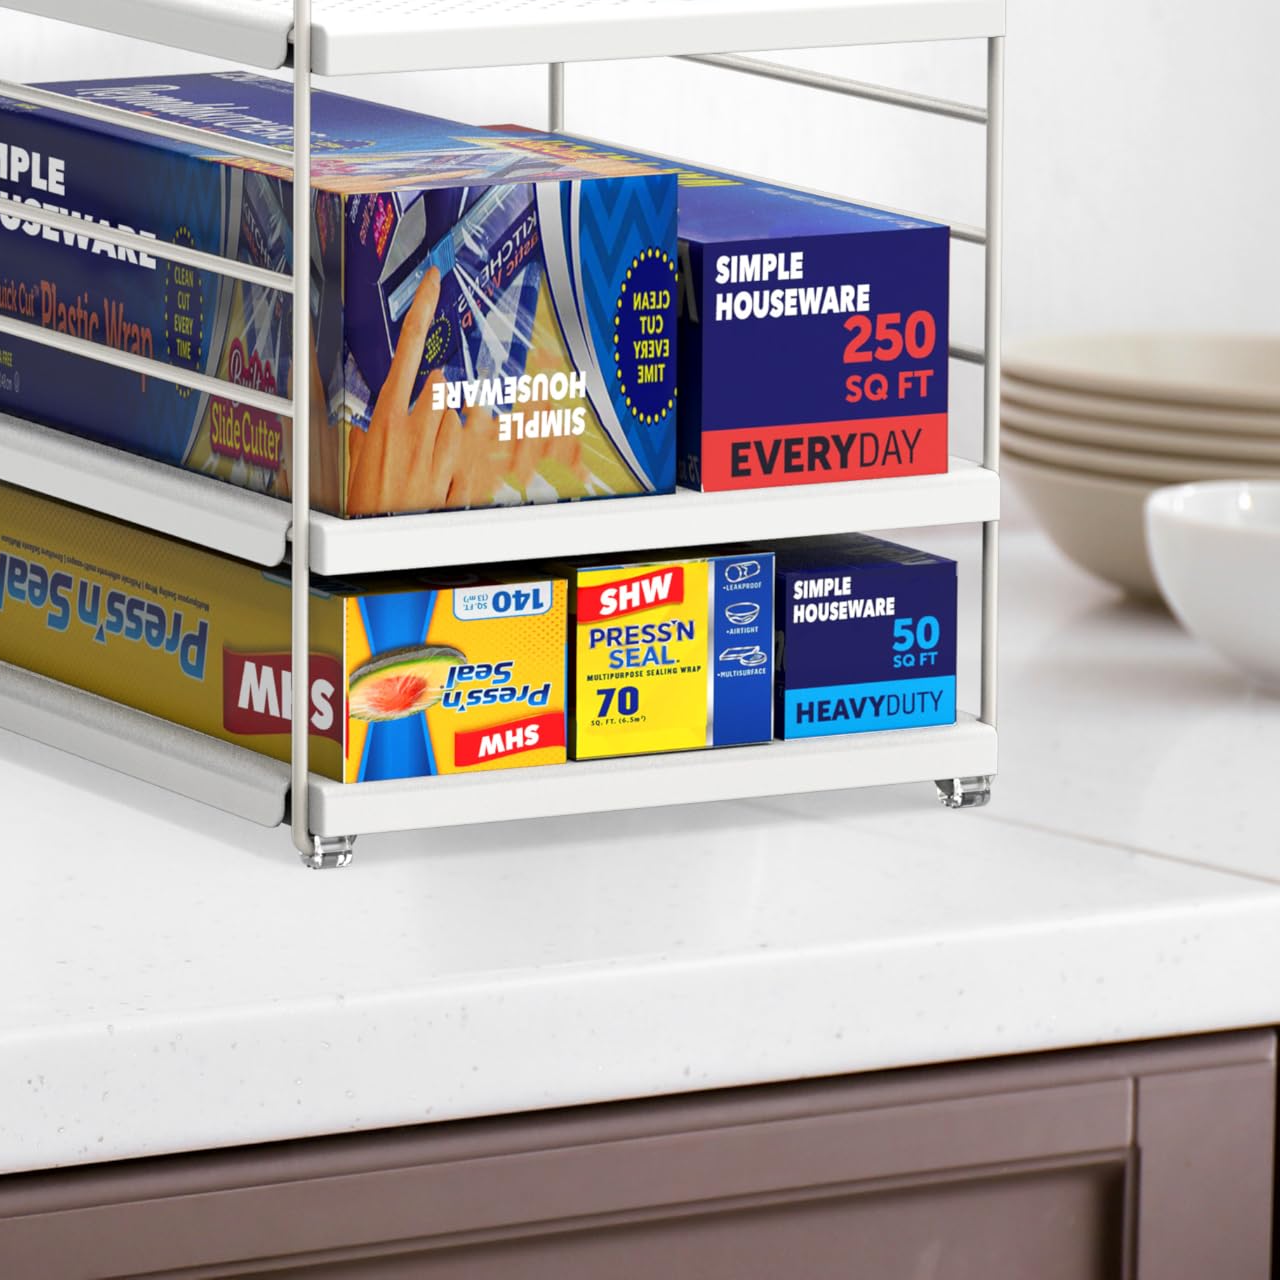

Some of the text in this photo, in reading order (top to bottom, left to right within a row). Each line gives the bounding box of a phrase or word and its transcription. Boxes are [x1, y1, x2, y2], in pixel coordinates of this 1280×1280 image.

[174, 267, 194, 287] CLEAN
[715, 251, 804, 284] SIMPLE
[177, 290, 190, 311] CUT
[715, 283, 870, 321] HOUSEWARE
[19, 282, 34, 317] Cut
[41, 280, 100, 341] Plastic
[103, 297, 154, 393] Wrap
[174, 315, 193, 336] EVERY
[842, 310, 937, 364] 250
[176, 339, 191, 360] TIME
[432, 370, 587, 410] HOUSEWARE
[845, 370, 934, 403] SQ FT
[212, 401, 281, 462] Slide Cutter
[498, 407, 587, 442] SIMPLE
[730, 428, 923, 478] EVERYDAY
[492, 588, 544, 612] 140
[599, 572, 672, 616] SHW
[793, 576, 851, 600] SIMPLE
[793, 597, 895, 624] HOUSEWARE
[589, 620, 695, 650] PRESS'N
[892, 616, 940, 652] 50
[609, 645, 675, 670] SEAL
[893, 652, 938, 668] SQ FT
[445, 661, 515, 689] Seal
[587, 671, 643, 682] MULTIPURPOSE
[646, 668, 678, 677] SEALING
[596, 686, 639, 718] 70
[796, 690, 943, 723] HEAVYDUTY
[478, 724, 540, 757] SHW
